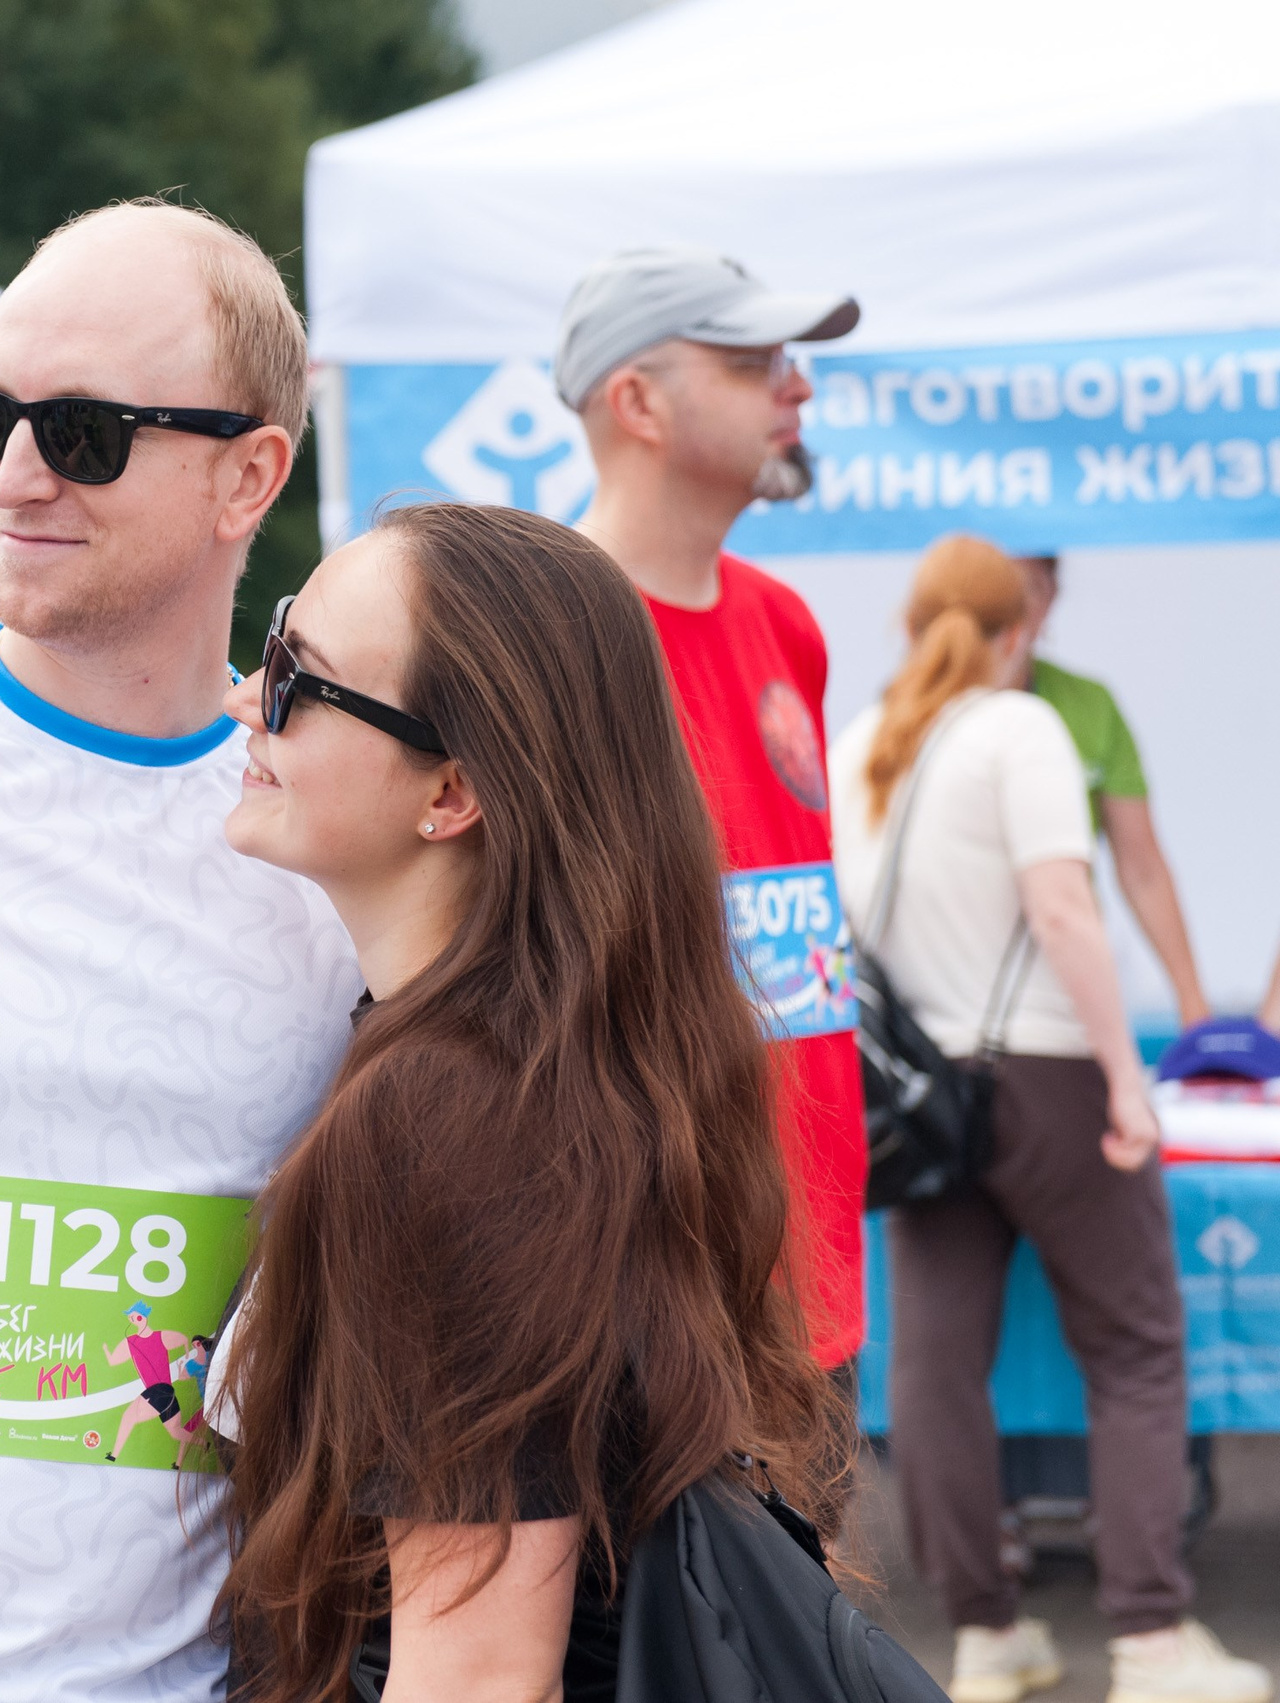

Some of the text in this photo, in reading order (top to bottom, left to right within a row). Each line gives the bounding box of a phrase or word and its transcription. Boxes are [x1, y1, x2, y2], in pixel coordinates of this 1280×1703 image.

[752, 438, 1280, 516] иния жиз
[732, 875, 832, 939] 3075
